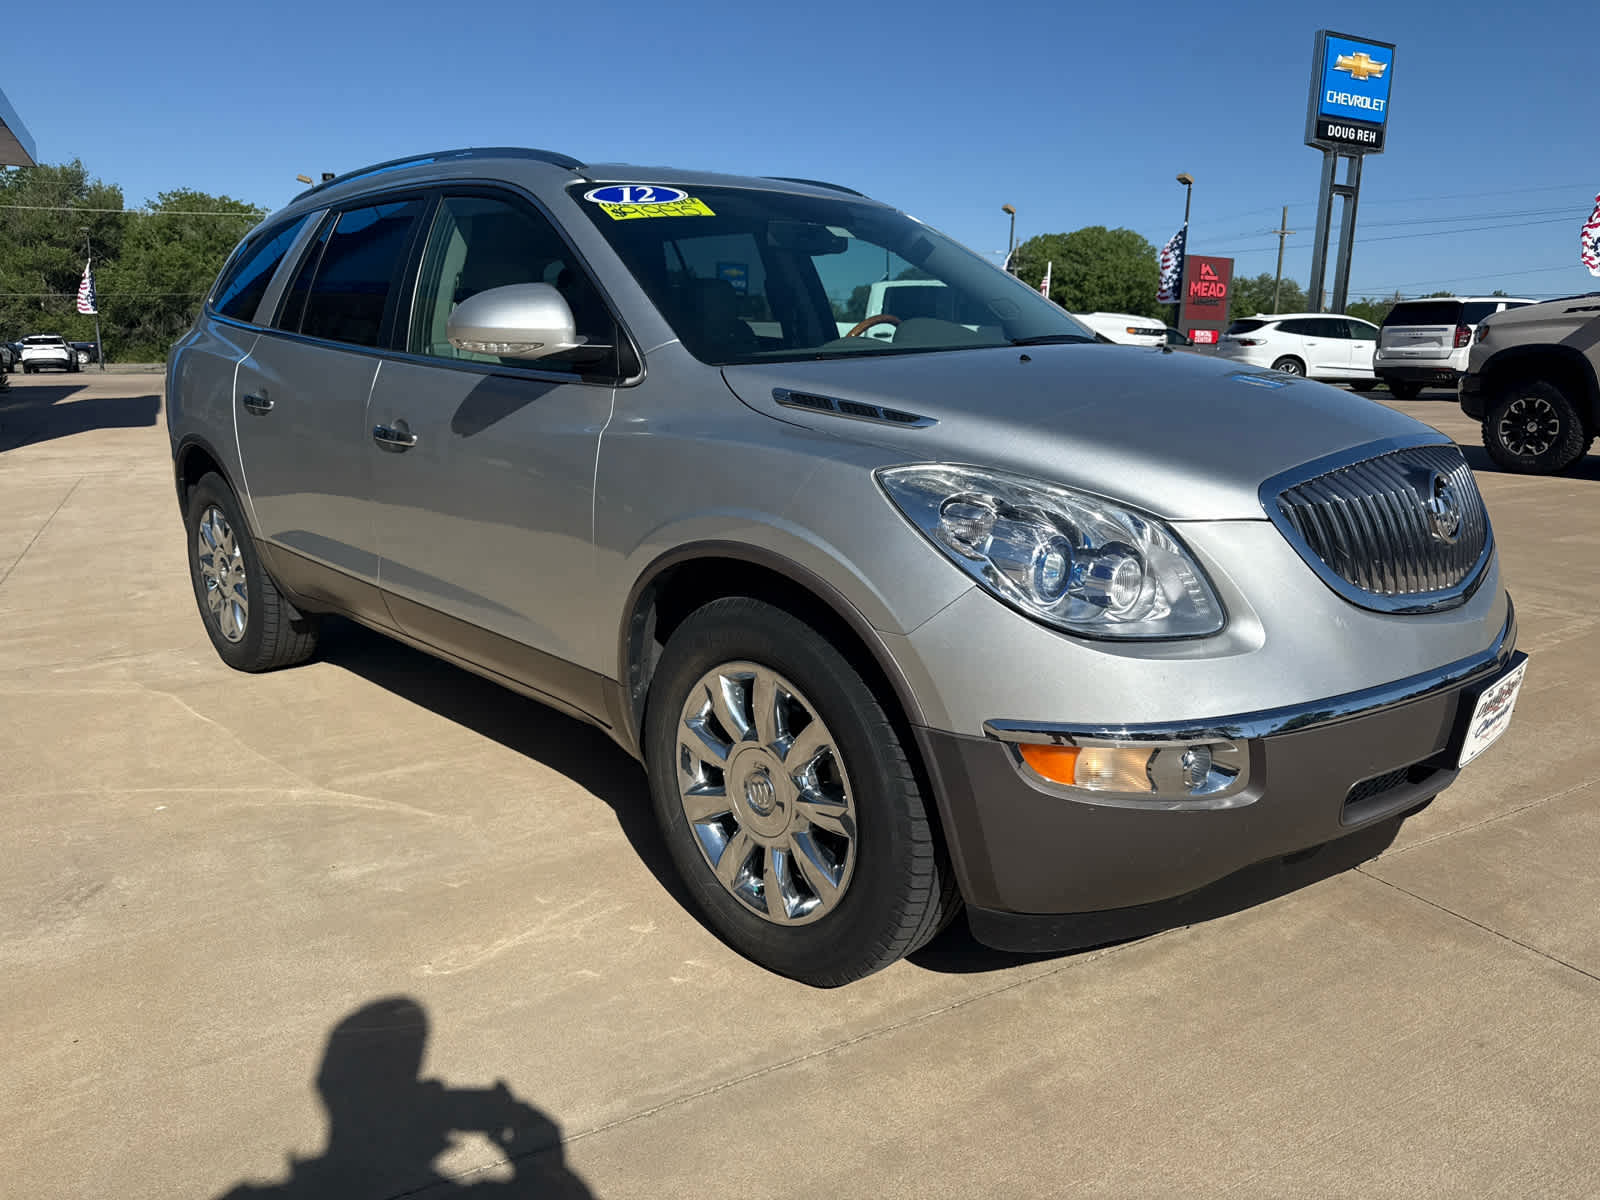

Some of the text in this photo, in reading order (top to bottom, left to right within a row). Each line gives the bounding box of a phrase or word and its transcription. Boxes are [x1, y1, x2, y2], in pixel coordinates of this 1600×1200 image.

[1326, 90, 1386, 112] CHEVROLET
[1327, 124, 1377, 143] DOUG REH
[618, 186, 656, 203] 12
[1190, 281, 1227, 298] MEAD
